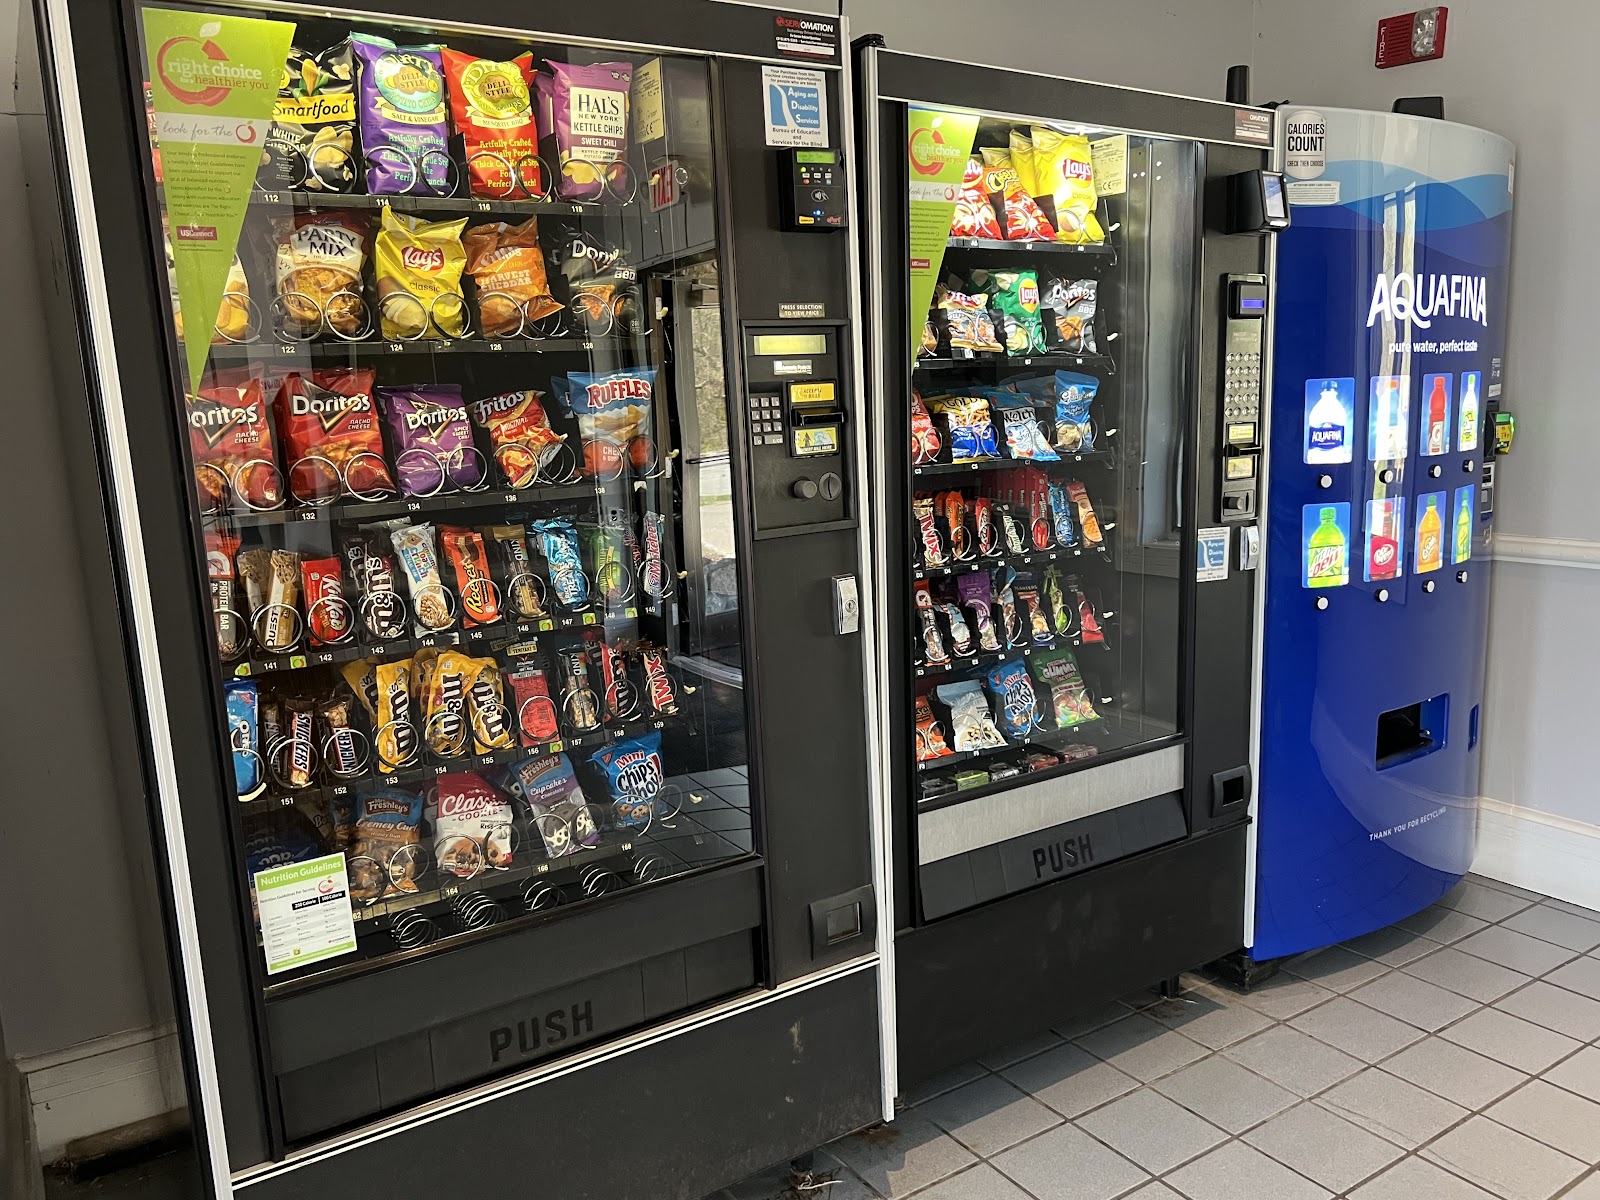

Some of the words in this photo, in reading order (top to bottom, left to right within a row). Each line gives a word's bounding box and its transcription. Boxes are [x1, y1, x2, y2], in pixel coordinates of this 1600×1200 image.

[1379, 26, 1387, 59] FIRE
[167, 61, 211, 79] right
[211, 62, 262, 80] choice
[400, 79, 425, 88] STYLE
[486, 81, 507, 91] DELI
[485, 87, 512, 97] STYLE
[788, 88, 807, 99] Aging
[271, 98, 350, 120] Smartfood
[578, 93, 620, 116] HAL'S
[791, 101, 819, 112] Disability
[391, 111, 407, 122] SALT
[413, 114, 440, 124] VINEGAR
[578, 113, 596, 121] NEW
[599, 115, 619, 123] YORK
[795, 114, 819, 125] Services
[161, 121, 188, 135] look
[190, 122, 209, 141] for
[211, 123, 233, 138] the
[272, 127, 302, 144] WHITE
[573, 122, 602, 133] KETTLE
[603, 125, 624, 136] CHIPS
[1287, 123, 1326, 135] CALORIES
[581, 137, 601, 146] SWEET
[602, 138, 617, 148] CHILI
[914, 143, 935, 156] right
[935, 145, 961, 156] choice
[1287, 136, 1325, 152] COUNT
[1064, 159, 1092, 180] Lay's
[263, 194, 278, 203] 112
[1072, 191, 1093, 201] Classic
[296, 229, 357, 248] PARTY
[308, 242, 349, 257] MIX
[402, 246, 443, 272] Lay's
[480, 269, 531, 286] HARVEST
[613, 270, 636, 282] BBQ
[409, 281, 442, 293] Classic
[480, 277, 533, 292] CHEDDAR
[1021, 287, 1038, 305] Lay's
[1365, 272, 1488, 329] AQUAFINA
[281, 346, 295, 354] 122
[389, 344, 403, 352] 124
[1388, 340, 1412, 355] pure
[1412, 339, 1439, 355] water,
[1439, 338, 1464, 354] perfect
[1463, 339, 1478, 352] taste
[585, 378, 651, 409] RUFFLES
[292, 394, 372, 416] Doritos
[474, 390, 525, 424] Fritos
[406, 406, 468, 430] Doritos
[234, 431, 259, 439] NACHO
[452, 430, 469, 438] SWEET
[453, 425, 469, 434] SPICY
[1311, 429, 1343, 443] AQUAFINA
[234, 436, 260, 444] CHEESE
[593, 486, 605, 494] 138
[504, 494, 517, 503] 136
[407, 503, 420, 511] 134
[301, 512, 315, 521] 132
[510, 538, 524, 561] KIND
[410, 546, 429, 579] Crunch
[219, 613, 230, 631] BAR
[266, 611, 280, 647] QUEST
[516, 624, 529, 633] 146
[561, 618, 572, 626] 147
[421, 639, 434, 647] 144
[470, 632, 483, 640] 145
[370, 646, 384, 655] 143
[318, 653, 334, 663] 142
[570, 652, 582, 676] KIND
[263, 661, 278, 671] 141
[1042, 663, 1078, 680] GUMMI
[646, 656, 675, 712] TWIX
[1003, 671, 1021, 690] Mini
[1004, 676, 1030, 705] Chips
[238, 719, 251, 758] OREO
[293, 712, 313, 774] SNICKERS
[570, 738, 582, 746] 157
[527, 747, 539, 755] 156
[481, 757, 494, 765] 155
[523, 754, 560, 779] Freshley's
[615, 750, 646, 771] Mini
[434, 766, 447, 775] 154
[616, 759, 655, 792] Chips
[385, 777, 398, 785] 153
[530, 777, 568, 797] Cupcakes
[333, 787, 347, 796] 152
[540, 786, 565, 800] Chocolate
[280, 797, 294, 806] 151
[367, 799, 409, 814] Freshley's
[355, 817, 395, 832] Cremey
[395, 820, 419, 833] Curl
[1369, 827, 1393, 842] THANK
[1392, 822, 1407, 834] YOU
[1406, 817, 1419, 829] FOR
[1419, 805, 1448, 824] RECYCLING
[620, 843, 632, 852] 168
[1032, 833, 1095, 879] PUSH
[260, 871, 299, 887] Nutrition
[299, 860, 342, 877] Guidelines
[536, 864, 549, 873] 166
[259, 896, 275, 904] Nutrition
[276, 893, 294, 901] Guidelines
[301, 886, 316, 896] Serving
[445, 887, 458, 896] 164
[489, 1000, 594, 1063] PUSH
